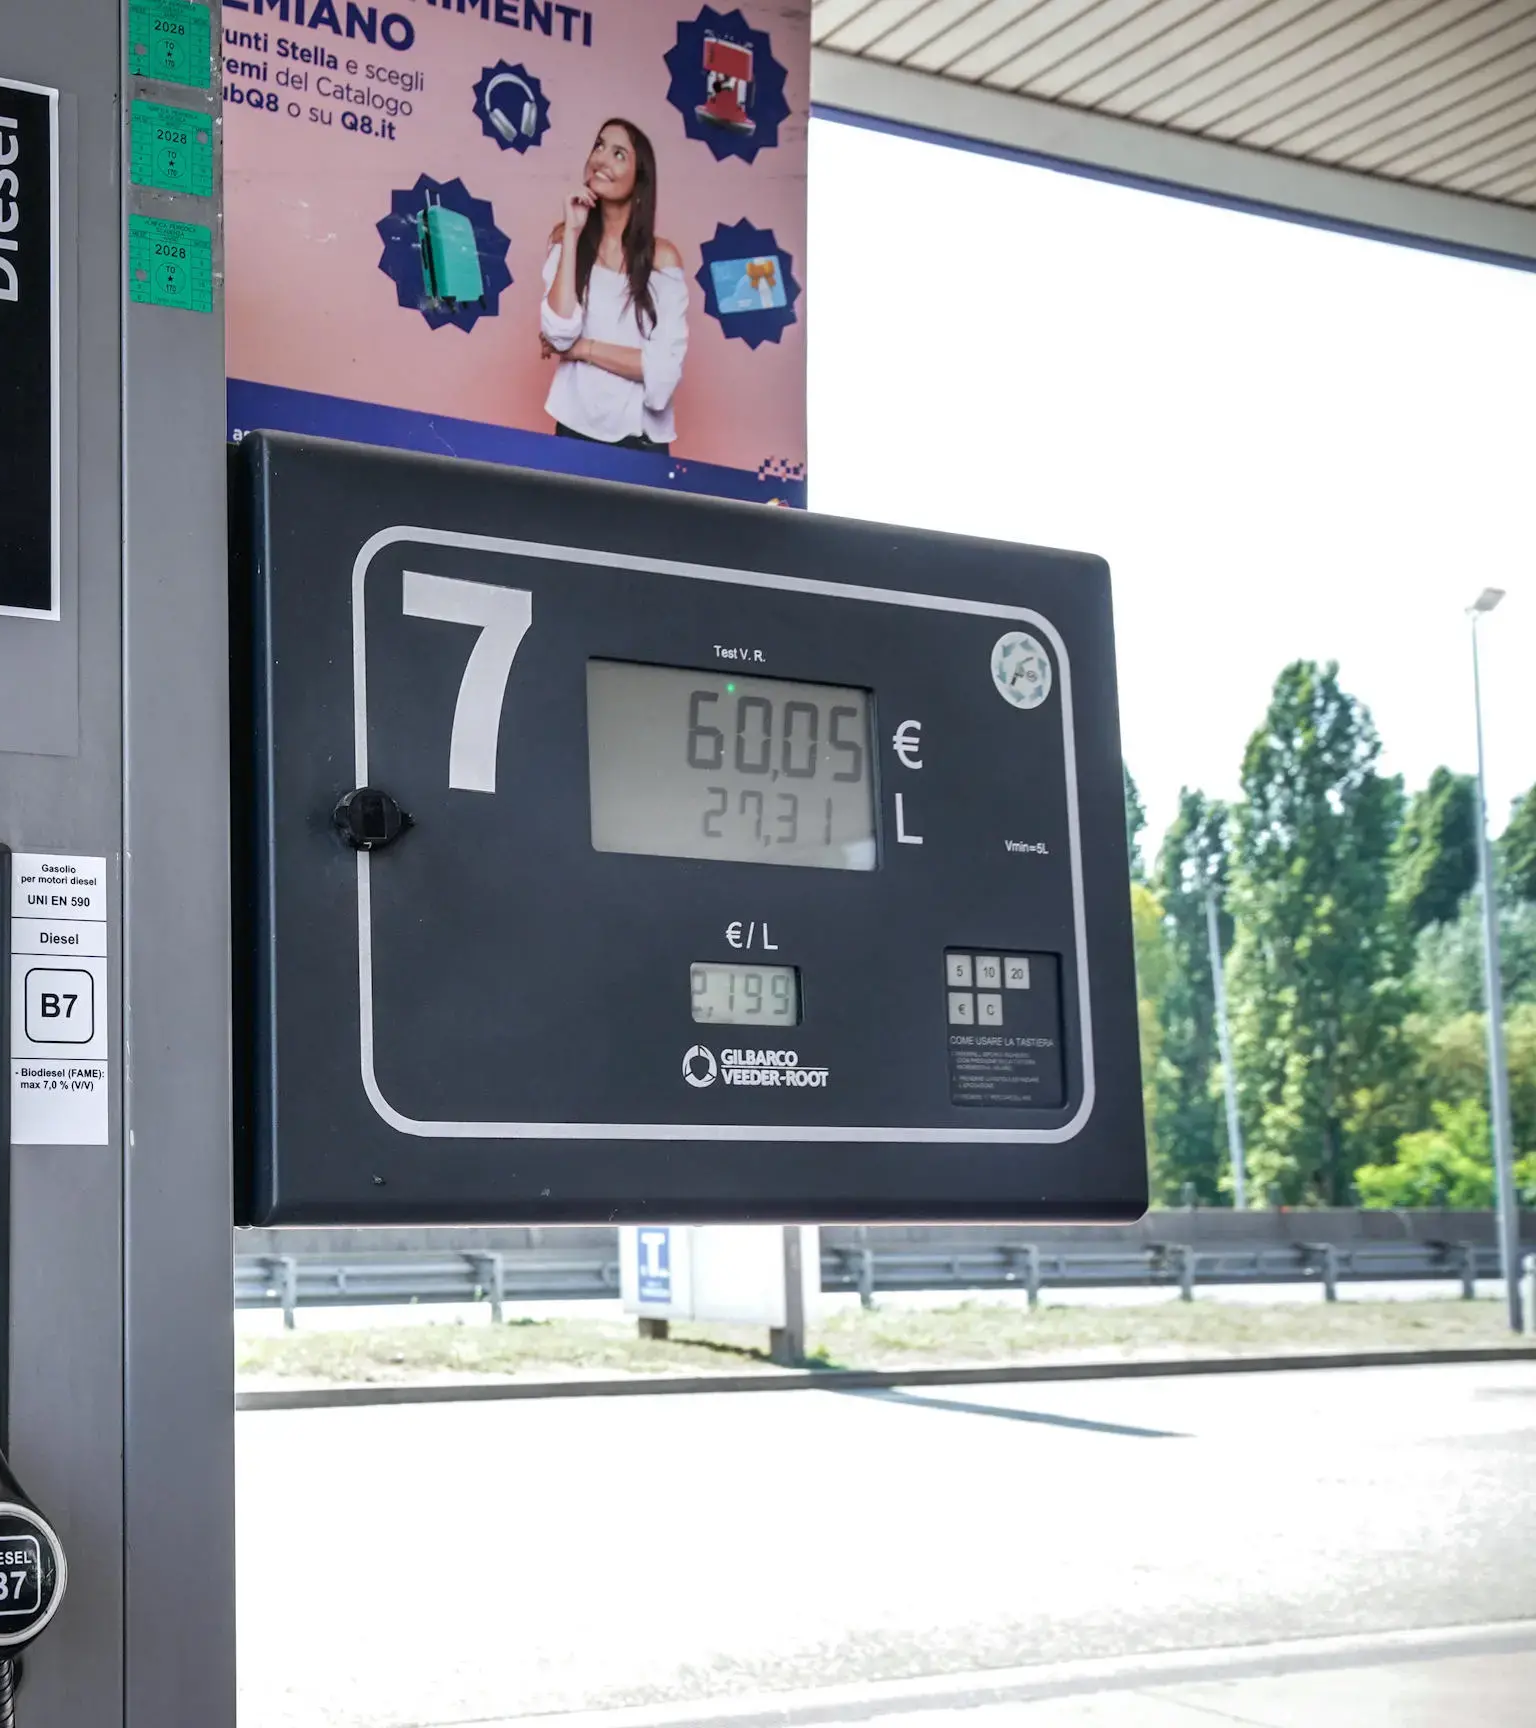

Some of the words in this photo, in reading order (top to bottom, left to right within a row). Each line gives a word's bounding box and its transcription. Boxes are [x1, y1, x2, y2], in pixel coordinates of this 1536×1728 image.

[154, 20, 185, 35] 2028
[222, 0, 415, 51] MIANO
[222, 27, 268, 52] unti
[276, 38, 338, 70] Stella
[345, 59, 358, 74] e
[365, 64, 425, 92] scegli
[222, 57, 268, 81] emi
[276, 68, 308, 92] del
[316, 76, 413, 117] Catalogo
[287, 102, 301, 118] o
[309, 107, 333, 125] su
[341, 112, 396, 141] Q8.it
[156, 129, 187, 144] 2028
[155, 243, 186, 259] 2028
[714, 645, 738, 660] Test
[739, 648, 752, 661] V.
[754, 650, 766, 663] R.
[402, 570, 532, 794] 7
[686, 690, 862, 783] 60,05
[892, 720, 923, 769] €
[702, 787, 833, 847] 27,31
[895, 793, 923, 845] L
[41, 863, 77, 874] Gasolio
[21, 875, 37, 885] per
[38, 875, 68, 885] motori
[70, 876, 97, 886] diesel
[27, 894, 48, 905] UNI
[51, 895, 68, 906] EN
[71, 896, 90, 907] 590
[40, 932, 79, 945] Diesel
[956, 965, 964, 977] 5
[983, 966, 996, 978] 10
[1010, 968, 1024, 980] 20
[41, 993, 79, 1018] B7
[958, 1003, 967, 1016] €
[986, 1004, 996, 1016] C
[950, 1035, 974, 1046] COME
[975, 1036, 1003, 1047] USARE
[1004, 1037, 1015, 1047] LA
[1016, 1037, 1055, 1048] TASTIERA
[720, 1048, 799, 1067] GILBARCO
[21, 1068, 65, 1078] Biodiesel
[68, 1069, 105, 1080] (FAME):
[721, 1068, 829, 1087] VEEDER-ROOT
[20, 1081, 41, 1090] max
[43, 1080, 58, 1091] 7,0
[60, 1080, 69, 1090] %
[71, 1080, 94, 1092] (V/V)
